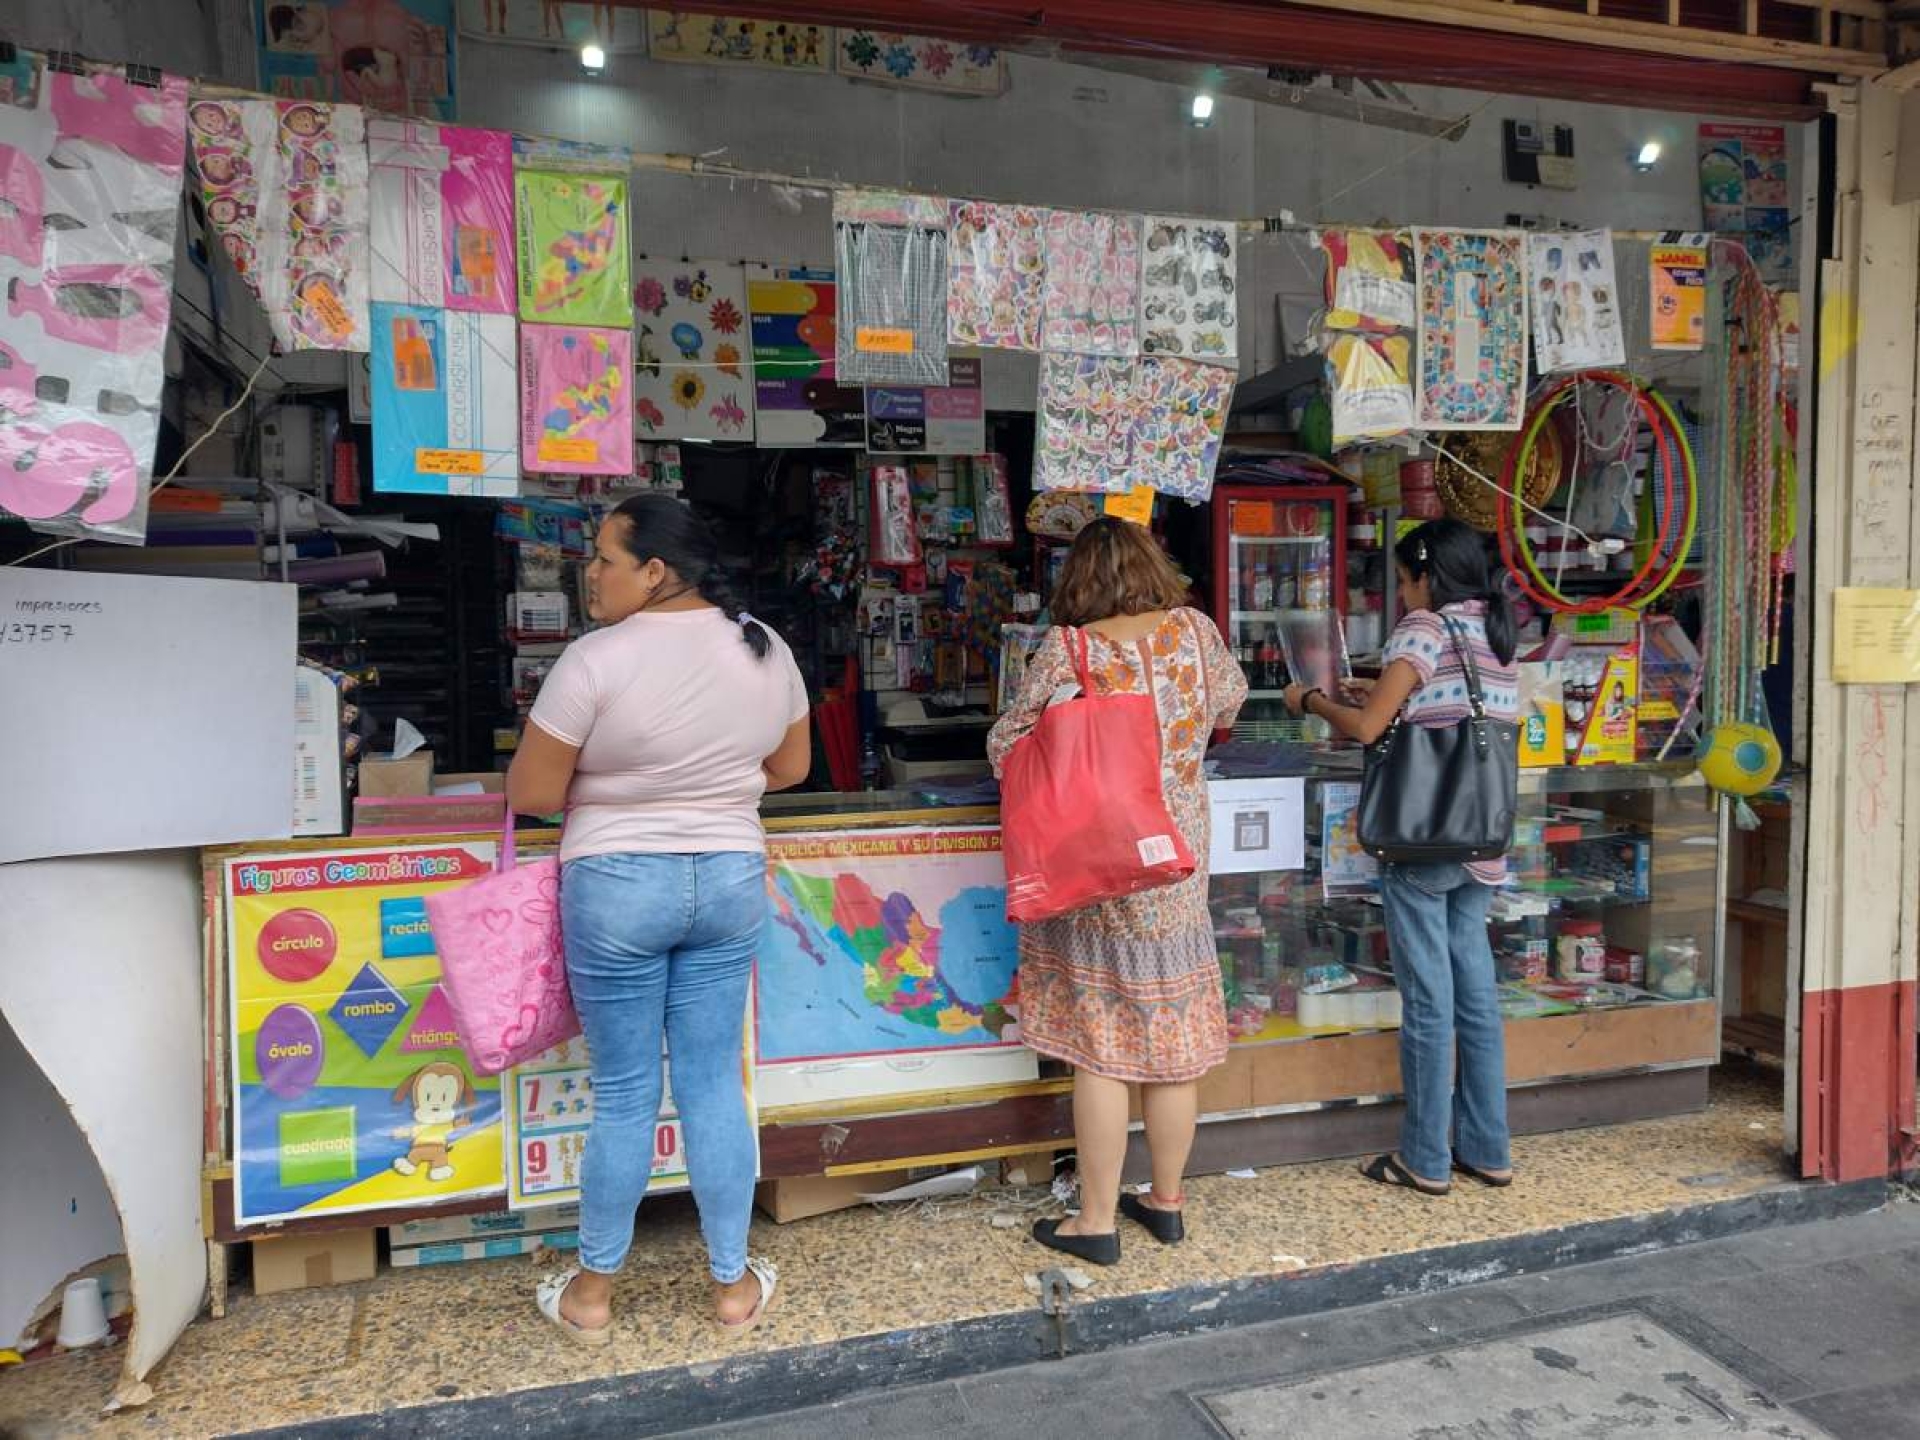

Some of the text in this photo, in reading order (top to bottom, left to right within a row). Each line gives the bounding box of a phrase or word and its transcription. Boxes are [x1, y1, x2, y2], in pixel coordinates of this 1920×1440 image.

[1654, 253, 1702, 264] JANEL
[844, 412, 865, 420] BLAC
[896, 424, 923, 434] Negro
[829, 840, 896, 856] MEXICANA
[902, 839, 911, 850] Y
[912, 837, 930, 850] SU
[239, 854, 462, 894] Figuras Geométricas
[389, 919, 433, 936] rectá
[271, 934, 324, 951] círculo
[343, 1001, 396, 1018] rombo
[268, 1041, 313, 1059] óvalo
[524, 1079, 540, 1113] 7
[283, 1135, 352, 1154] cuadrado
[527, 1140, 548, 1174] 9
